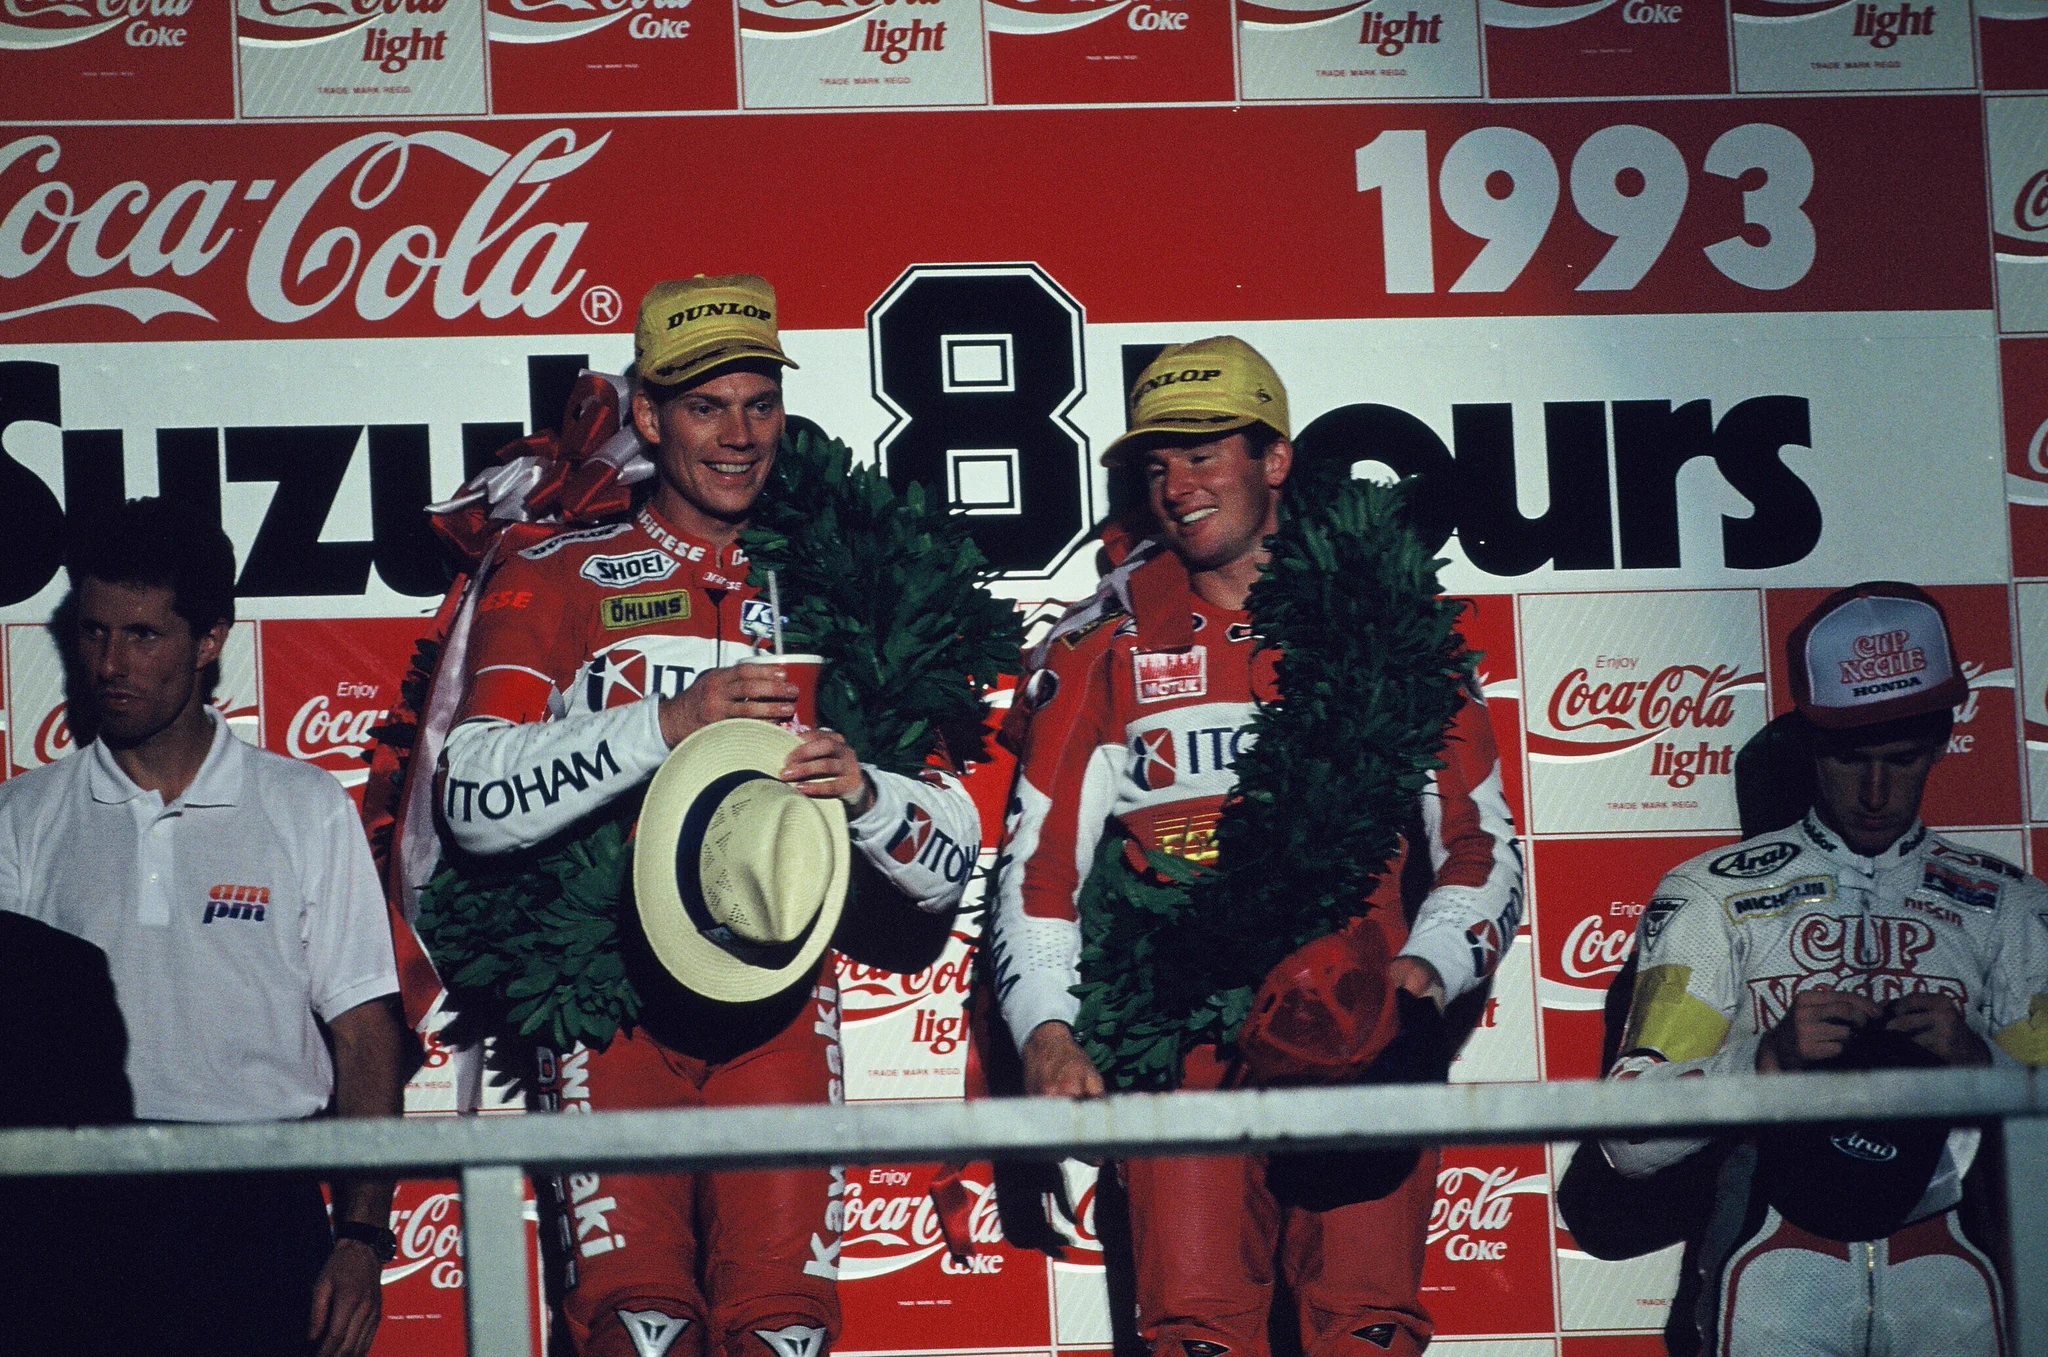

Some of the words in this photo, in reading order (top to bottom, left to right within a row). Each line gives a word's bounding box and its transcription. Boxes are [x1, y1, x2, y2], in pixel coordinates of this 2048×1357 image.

[629, 12, 690, 39] Coke
[1127, 4, 1189, 31] Coke
[1622, 0, 1683, 24] Coke
[1853, 2, 1936, 48] light
[125, 20, 187, 47] Coke
[862, 18, 947, 64] light
[1358, 10, 1443, 56] light
[362, 27, 447, 73] light
[1355, 122, 1817, 294] 1993
[666, 302, 772, 330] DUNLOP
[1121, 344, 1823, 577] ours
[598, 554, 664, 581] SHOEI
[610, 597, 683, 623] ÖHLINS
[1853, 629, 1910, 659] CUP
[1595, 655, 1639, 670] Enjoy
[337, 681, 379, 699] Enjoy
[1547, 664, 1740, 732] Coca-Cola
[1852, 676, 1923, 697] HONDA
[1650, 742, 1735, 789] light
[447, 739, 622, 822] ITOHAM
[1718, 847, 1788, 873] Arai
[209, 884, 271, 904] am
[202, 901, 266, 924] pm
[1790, 913, 1936, 973] CUP
[869, 1169, 912, 1186] Enjoy
[1446, 1234, 1508, 1261] Coke
